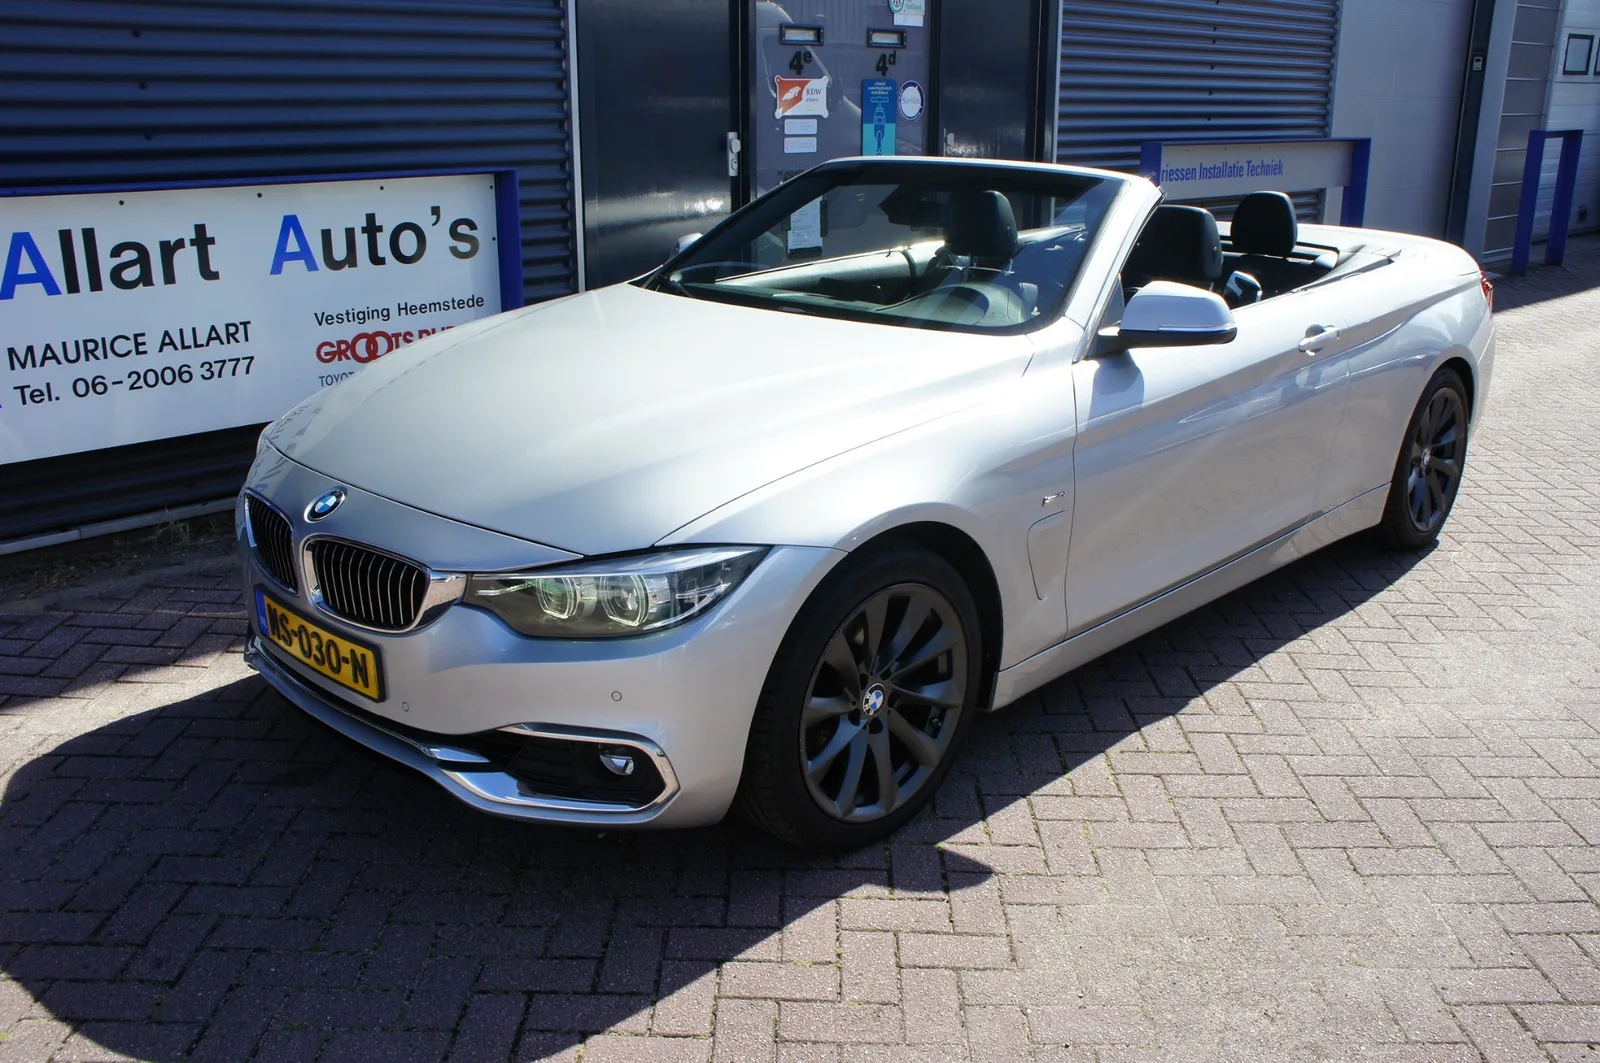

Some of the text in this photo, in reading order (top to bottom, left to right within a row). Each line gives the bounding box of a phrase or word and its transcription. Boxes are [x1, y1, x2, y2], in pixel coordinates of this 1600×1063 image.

[789, 50, 813, 76] 4e
[875, 50, 897, 77] 4d
[806, 88, 822, 96] RDW
[1161, 159, 1284, 182] riessen Installatie Techniek
[0, 206, 480, 300] Allart Auto's
[314, 294, 485, 326] Vestiging Heemstede
[7, 321, 251, 371] MAURICE ALLART
[13, 356, 255, 406] Tel. 06-2006 3777
[319, 371, 355, 388] TOYO
